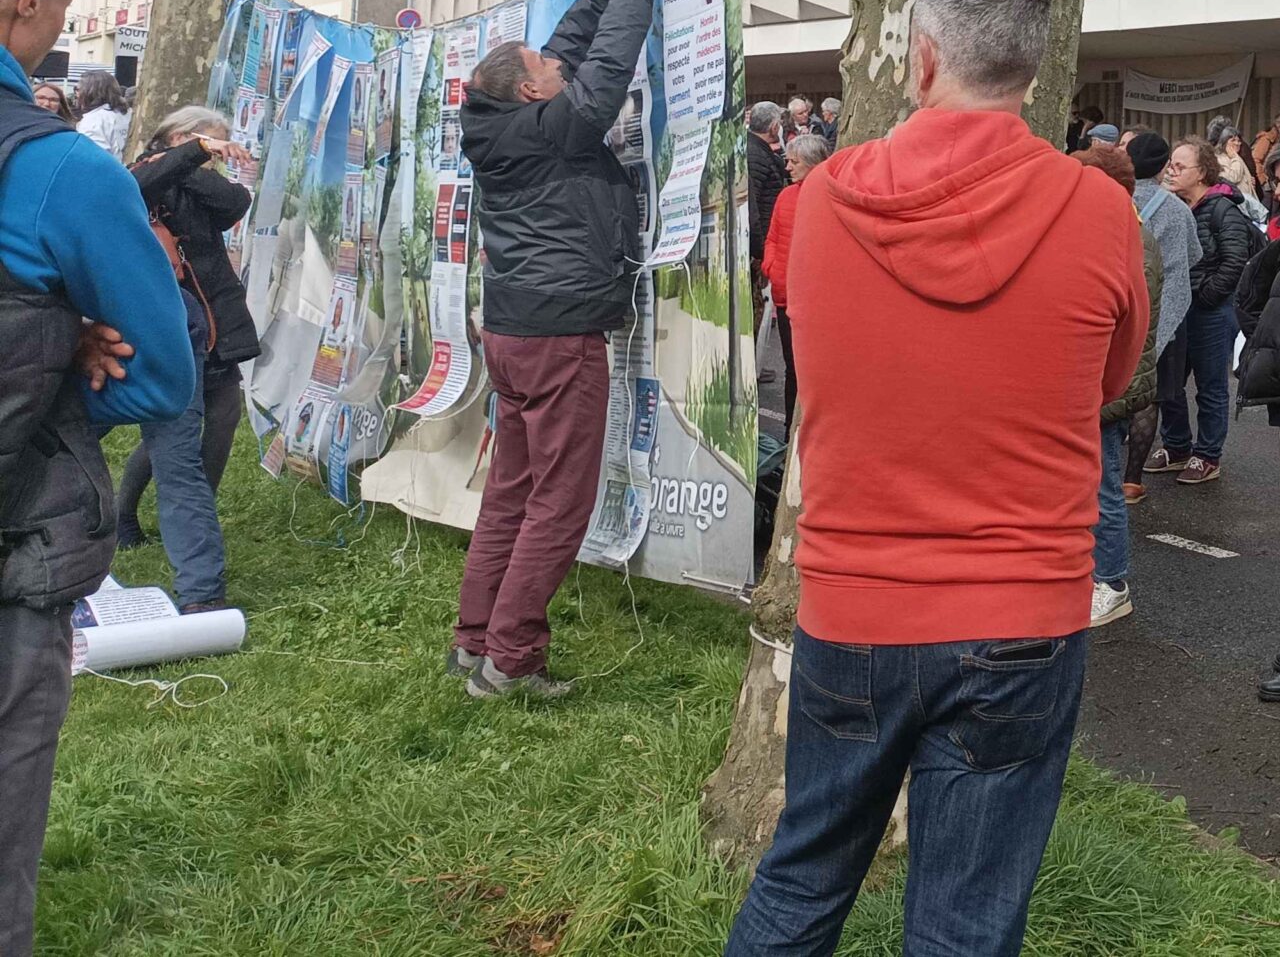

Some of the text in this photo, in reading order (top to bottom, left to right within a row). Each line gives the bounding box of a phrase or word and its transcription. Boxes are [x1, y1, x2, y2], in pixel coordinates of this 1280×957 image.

[700, 15, 714, 27] Honte
[664, 24, 695, 42] Félicitations
[695, 27, 721, 44] l'ordre des
[667, 40, 690, 57] pour avoir
[696, 43, 721, 59] médecins
[667, 53, 690, 71] respecté
[693, 57, 725, 76] pour ne pas
[672, 73, 686, 86] votre
[694, 70, 724, 90] avoir rempli
[1160, 82, 1177, 93] MERCI
[668, 88, 691, 105] serment
[696, 93, 706, 104] son
[706, 89, 718, 100] rôle
[688, 204, 700, 215] Covid
[650, 475, 729, 532] orange
[666, 522, 685, 538] vivre
